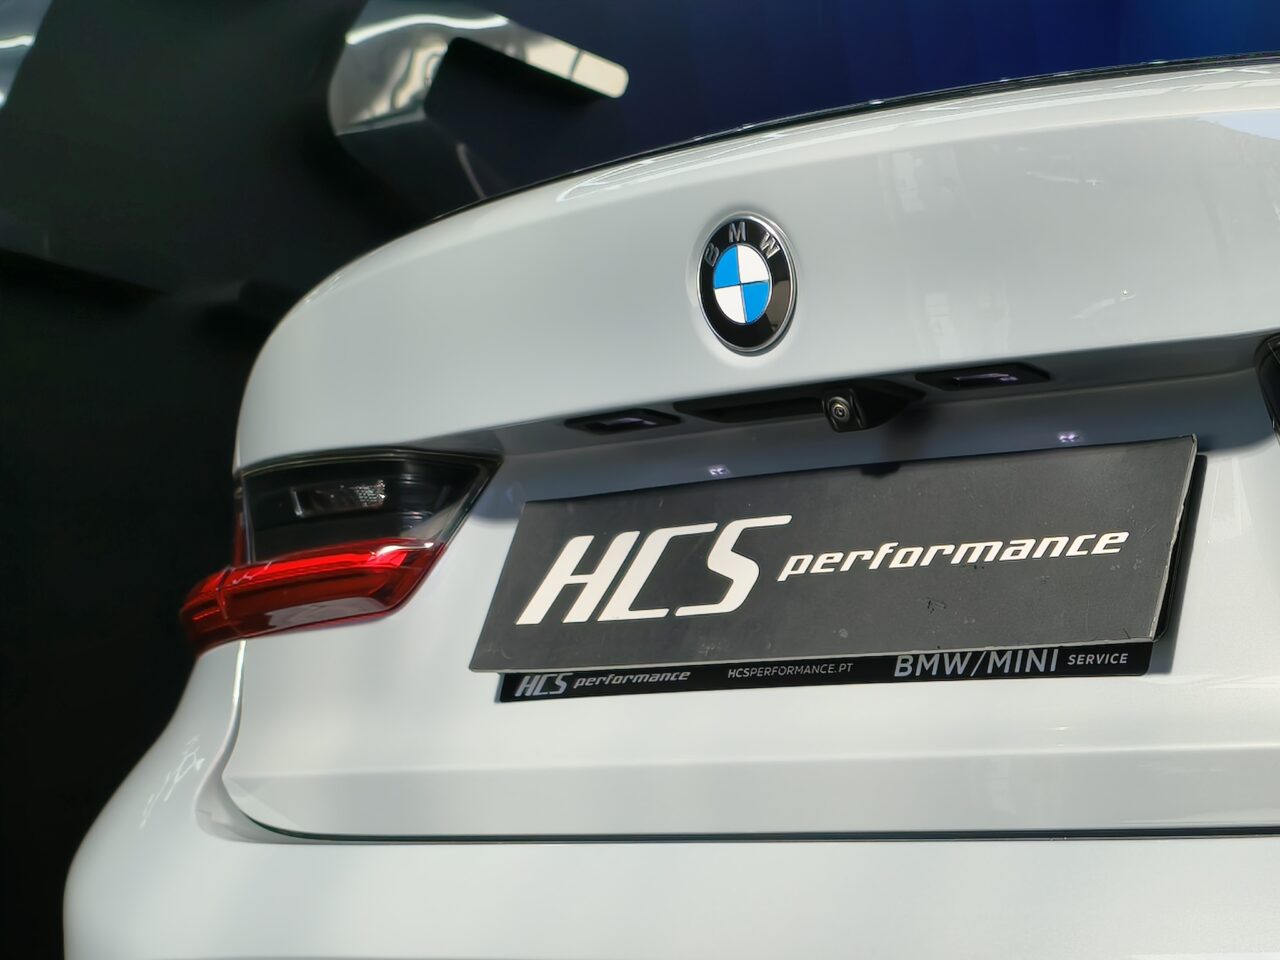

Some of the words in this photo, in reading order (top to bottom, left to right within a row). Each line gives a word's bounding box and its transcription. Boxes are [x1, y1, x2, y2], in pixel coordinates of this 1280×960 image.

[703, 221, 781, 267] BMW
[515, 515, 792, 627] HCS
[776, 531, 1130, 582] performance
[514, 672, 574, 697] HCS
[573, 671, 691, 689] performance
[727, 662, 854, 678] HCSPERFORMANCE.PT
[1067, 653, 1129, 666] SERVICE
